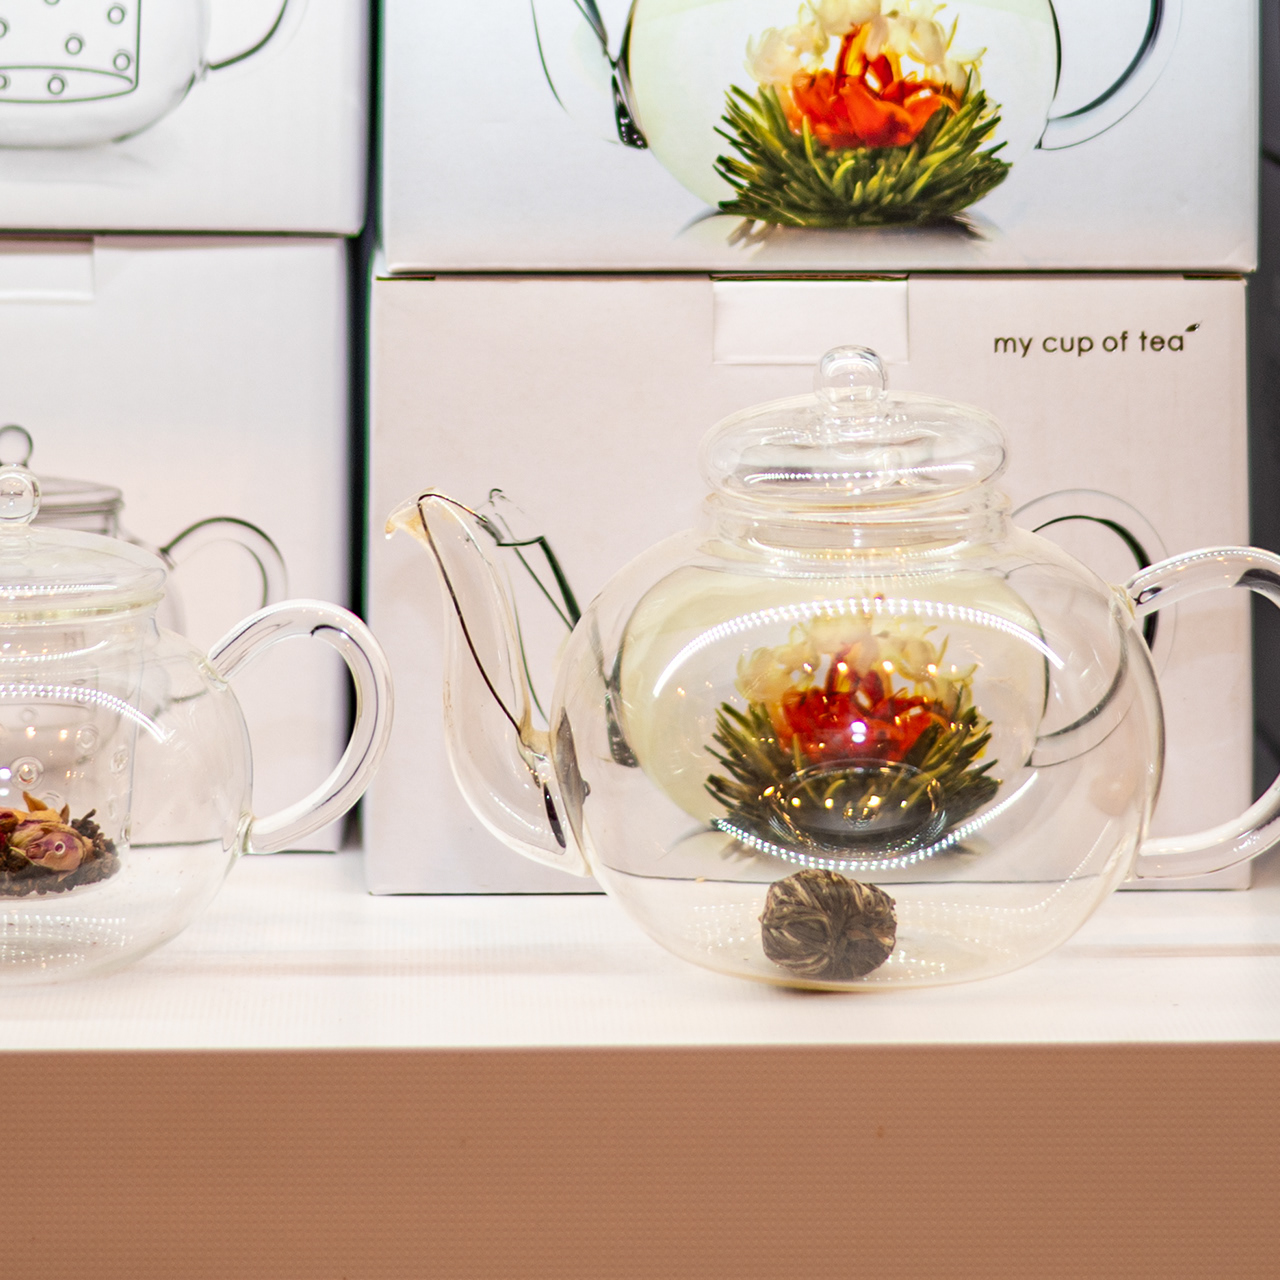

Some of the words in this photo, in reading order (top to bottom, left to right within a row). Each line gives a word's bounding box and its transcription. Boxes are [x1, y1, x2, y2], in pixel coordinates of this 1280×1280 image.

[993, 336, 1033, 358] my
[1042, 335, 1094, 358] cup
[1102, 330, 1128, 352] of
[1139, 330, 1184, 352] tea
